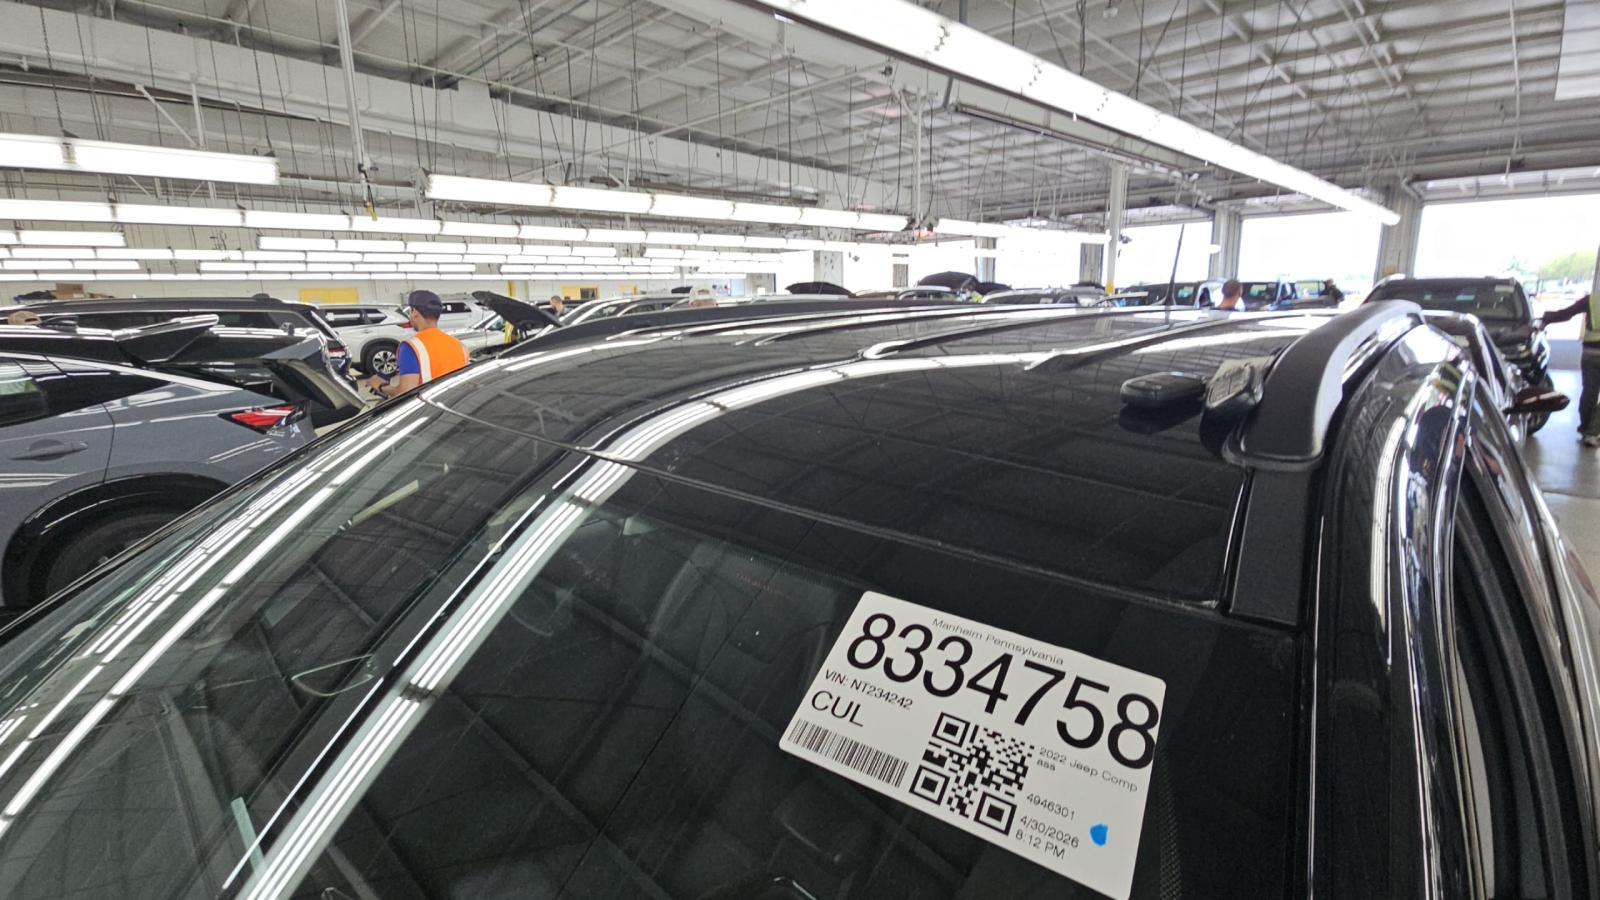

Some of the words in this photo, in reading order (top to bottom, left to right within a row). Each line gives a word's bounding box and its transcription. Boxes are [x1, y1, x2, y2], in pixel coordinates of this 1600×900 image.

[932, 617, 982, 640] Manheim
[985, 634, 1064, 665] Pennsylvania
[825, 668, 848, 688] VIN:
[851, 680, 913, 710] NT234242
[846, 612, 1160, 769] 8334758
[811, 690, 863, 728] CUL
[1036, 759, 1056, 772] ass
[1039, 747, 1067, 764] 2022
[1069, 760, 1098, 777] Jeep
[1101, 769, 1138, 792] Comp
[1026, 792, 1076, 820] 4946301
[1015, 829, 1041, 850] 8:12
[1044, 843, 1066, 860] PM
[1020, 815, 1079, 848] 4/30/2026
